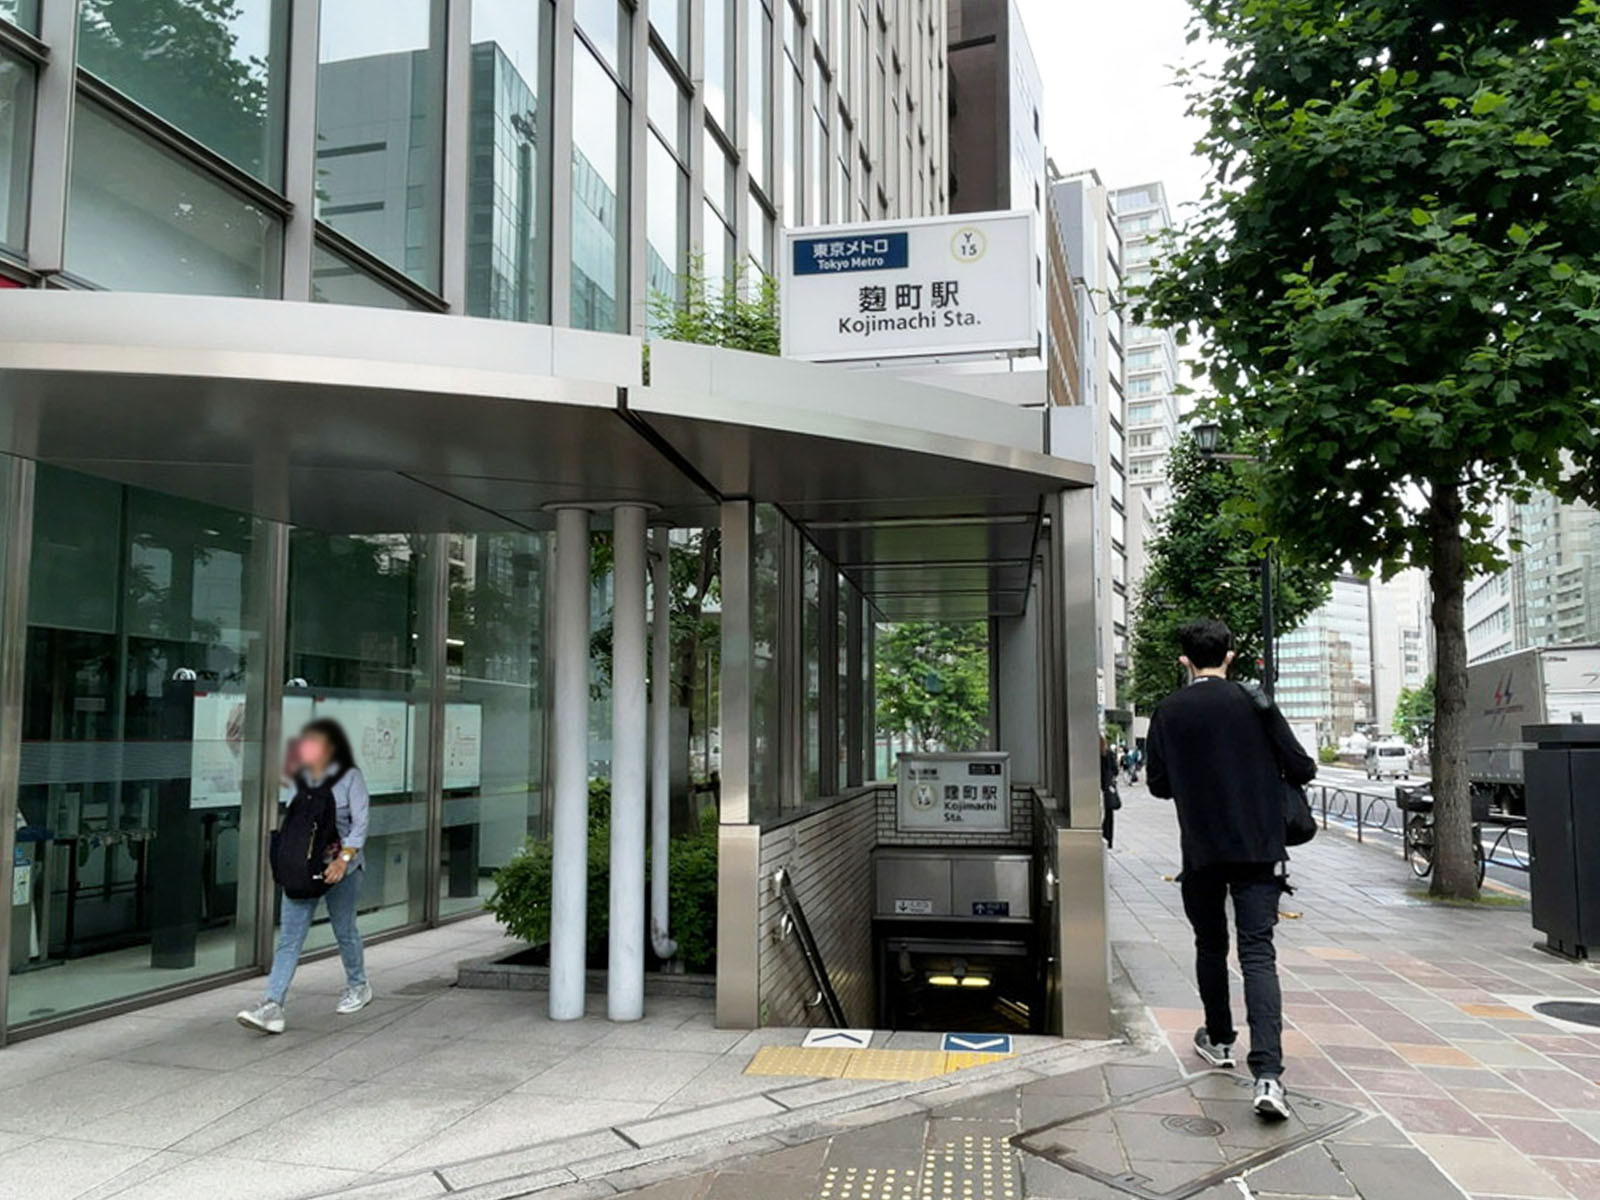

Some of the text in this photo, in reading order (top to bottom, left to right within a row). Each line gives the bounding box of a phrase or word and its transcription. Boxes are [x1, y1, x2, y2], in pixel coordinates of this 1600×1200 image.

[964, 232, 973, 243] Y
[813, 239, 888, 258] 東京メトロ
[962, 244, 977, 256] 15
[817, 256, 884, 271] Tokyo Metro
[839, 310, 981, 336] Kojimachi Sta.
[943, 801, 997, 812] Kojimachi
